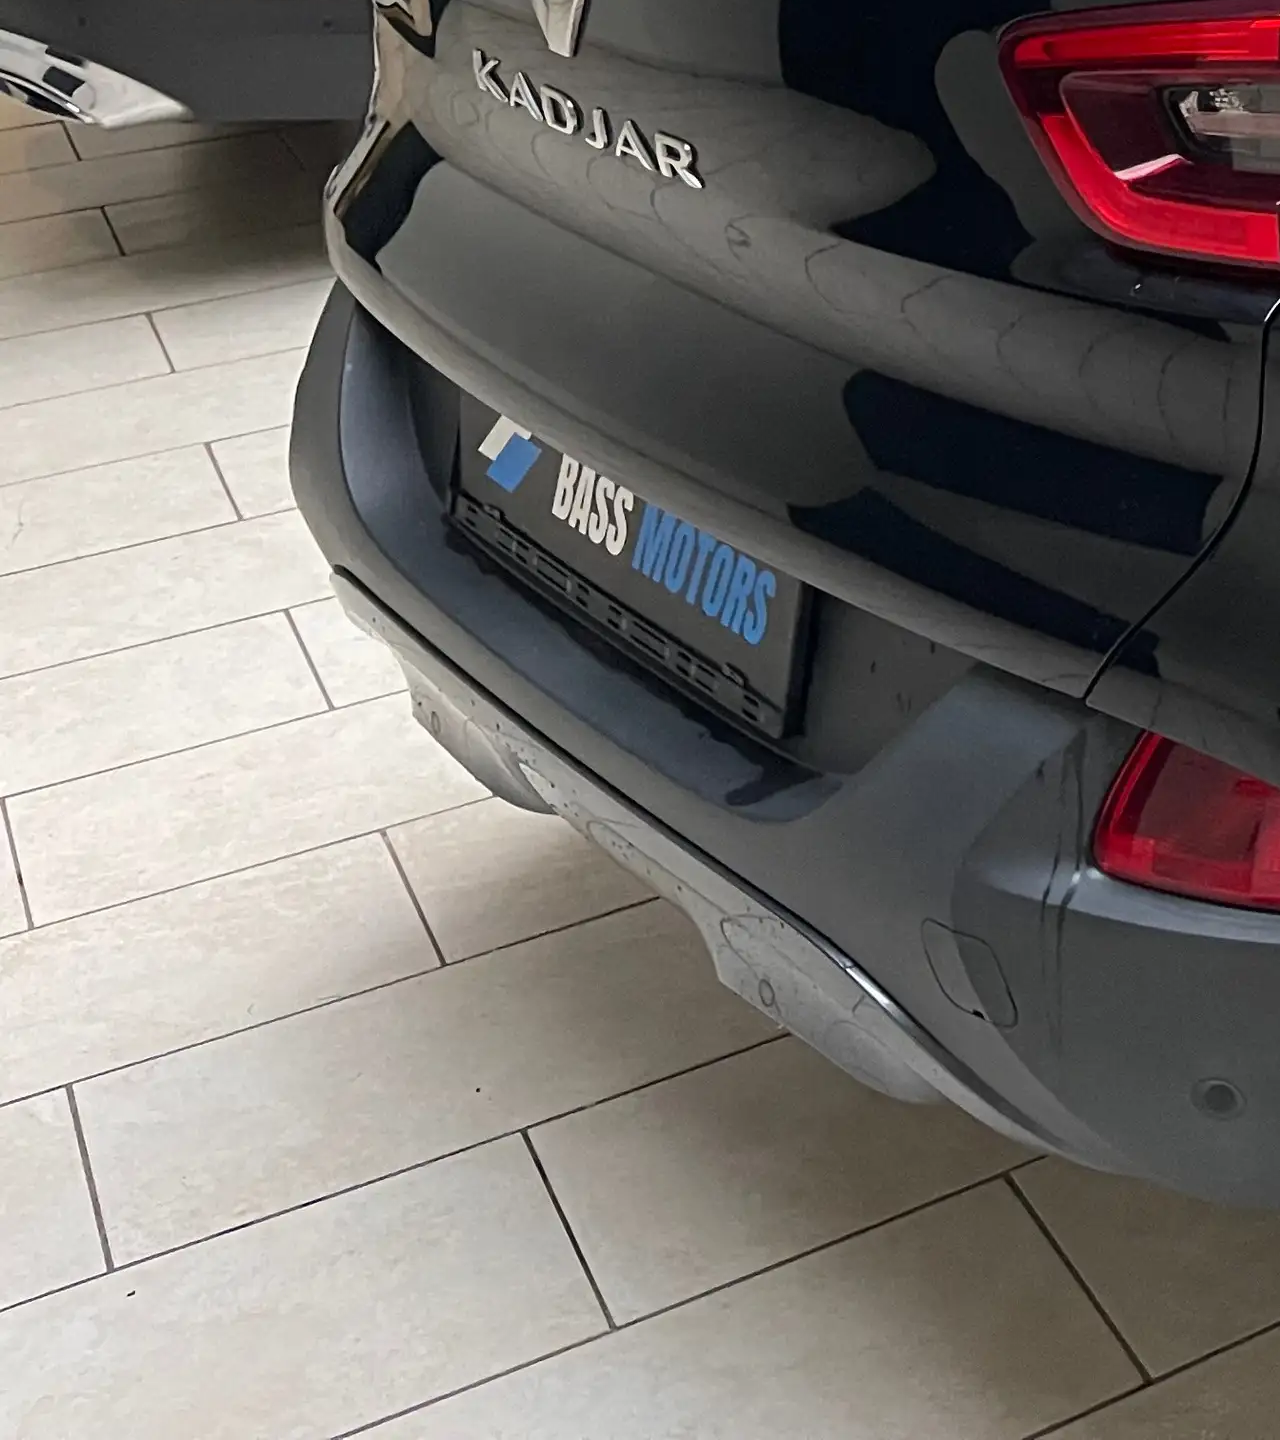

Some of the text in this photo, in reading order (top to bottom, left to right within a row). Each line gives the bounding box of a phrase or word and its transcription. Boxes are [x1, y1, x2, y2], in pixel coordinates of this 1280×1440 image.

[472, 48, 702, 189] KADJAR
[552, 453, 777, 646] BASS MOTORS
